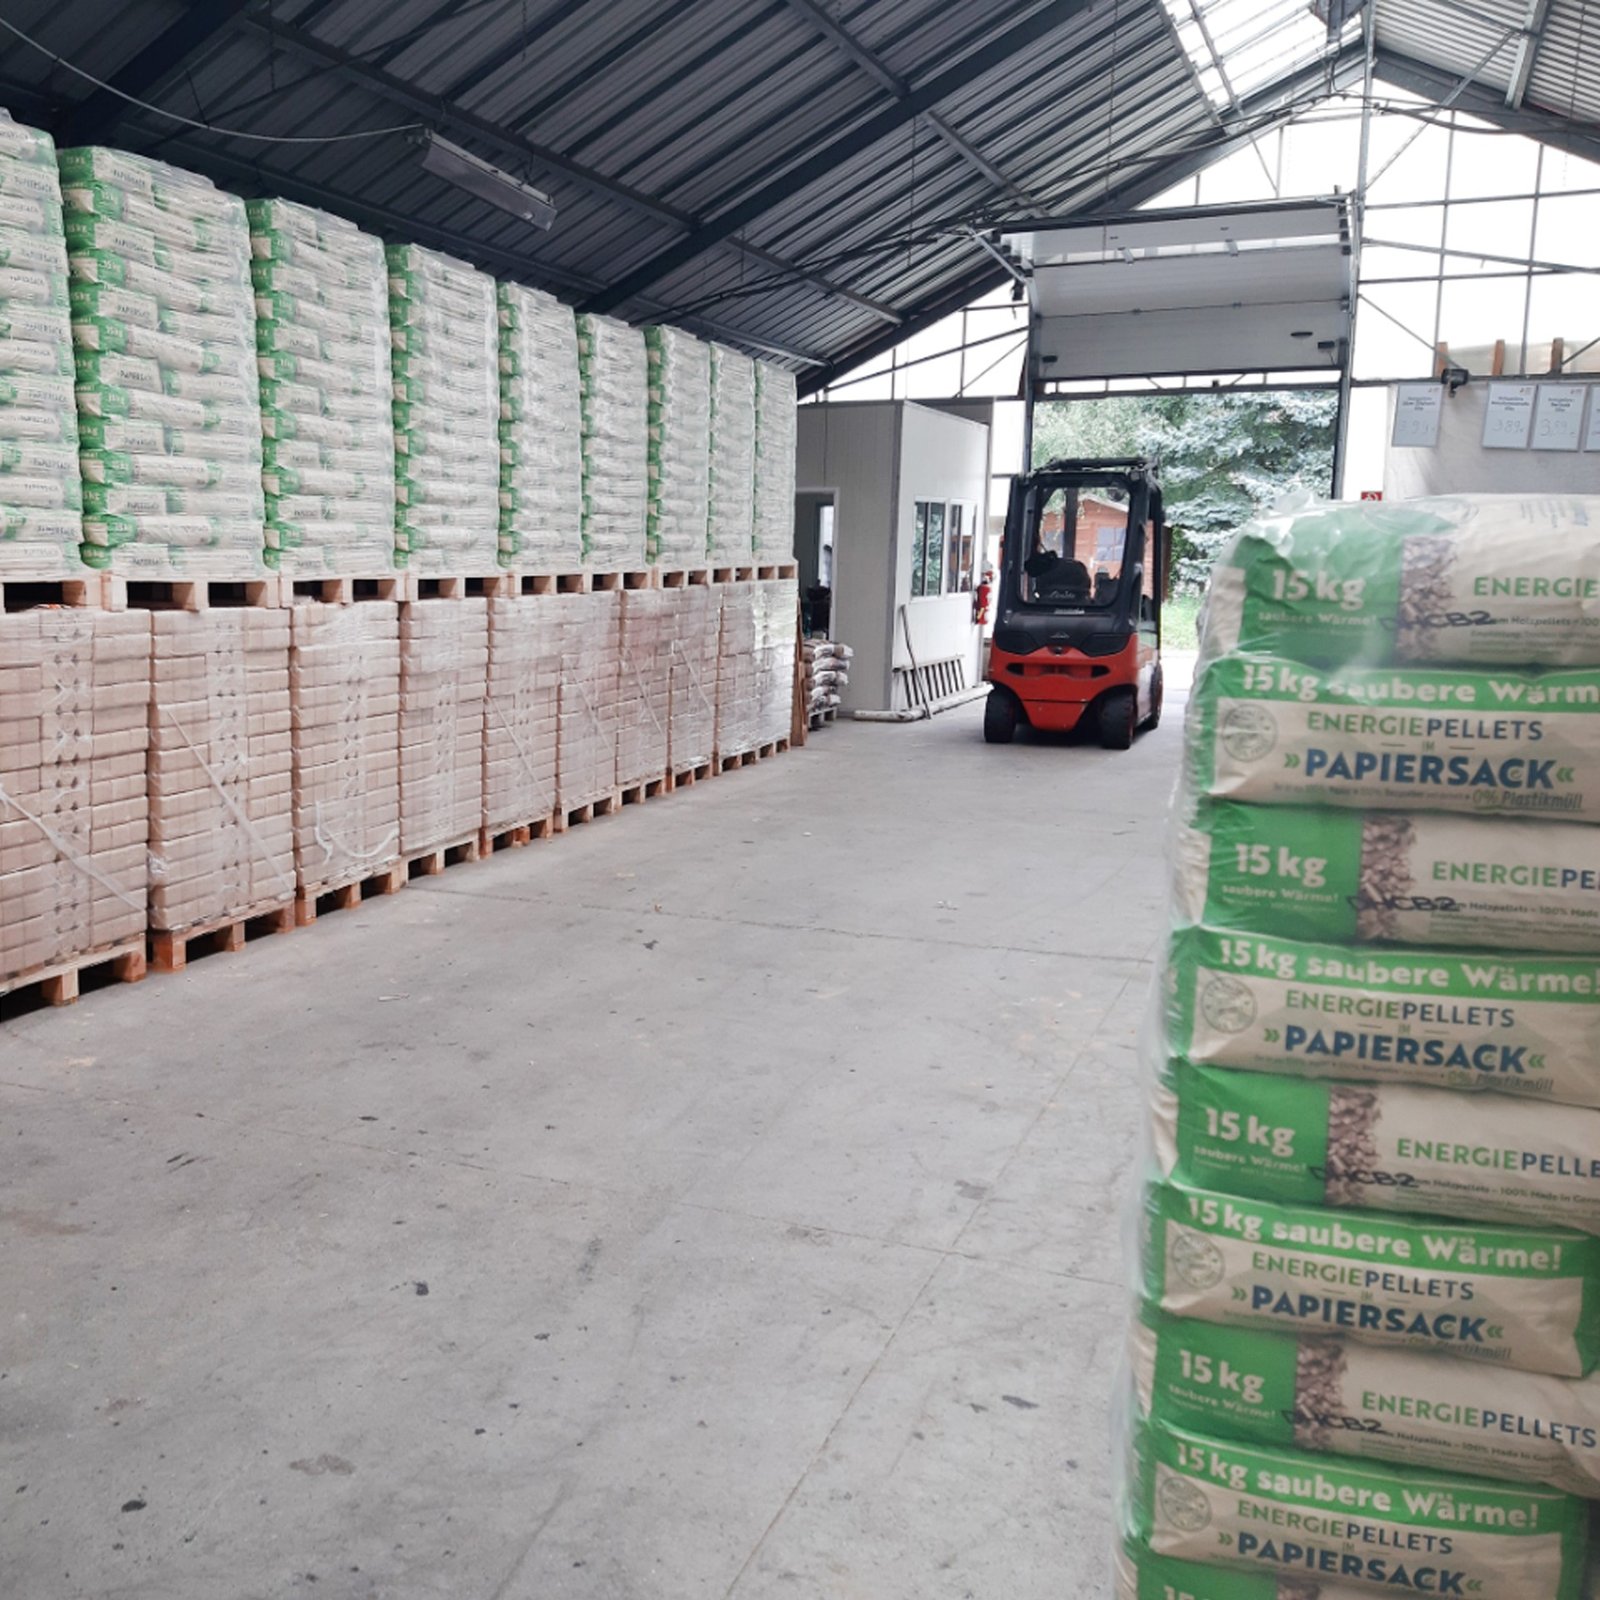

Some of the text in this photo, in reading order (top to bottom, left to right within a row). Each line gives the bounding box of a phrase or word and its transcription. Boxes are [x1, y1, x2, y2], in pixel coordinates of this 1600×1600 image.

[1272, 569, 1367, 611] 15 kg
[1243, 664, 1275, 692] 15
[1279, 666, 1320, 702] kg
[1307, 711, 1543, 741] ENERGIEPELLETS
[1236, 843, 1328, 888] 15 kg
[1432, 861, 1600, 889] ENERGIEPE
[1219, 939, 1251, 967] 15
[1256, 943, 1298, 980] kg
[1307, 956, 1449, 988] saubere
[1286, 989, 1515, 1028] ENERGIEPELLETS
[1206, 1107, 1295, 1157] 15 kg
[1188, 1197, 1562, 1271] 15 kg saubere Wärme!
[1253, 1251, 1474, 1300] ENERGIEPELLETS
[1179, 1349, 1265, 1404] 15 kg
[1362, 1390, 1597, 1449] ENERGIEPELLETS
[1177, 1442, 1205, 1471] 15
[1210, 1452, 1249, 1490] kg
[1257, 1470, 1392, 1511] saubere
[1401, 1489, 1540, 1528] Wärme!
[1238, 1500, 1453, 1554] ENERGIEPELLETS
